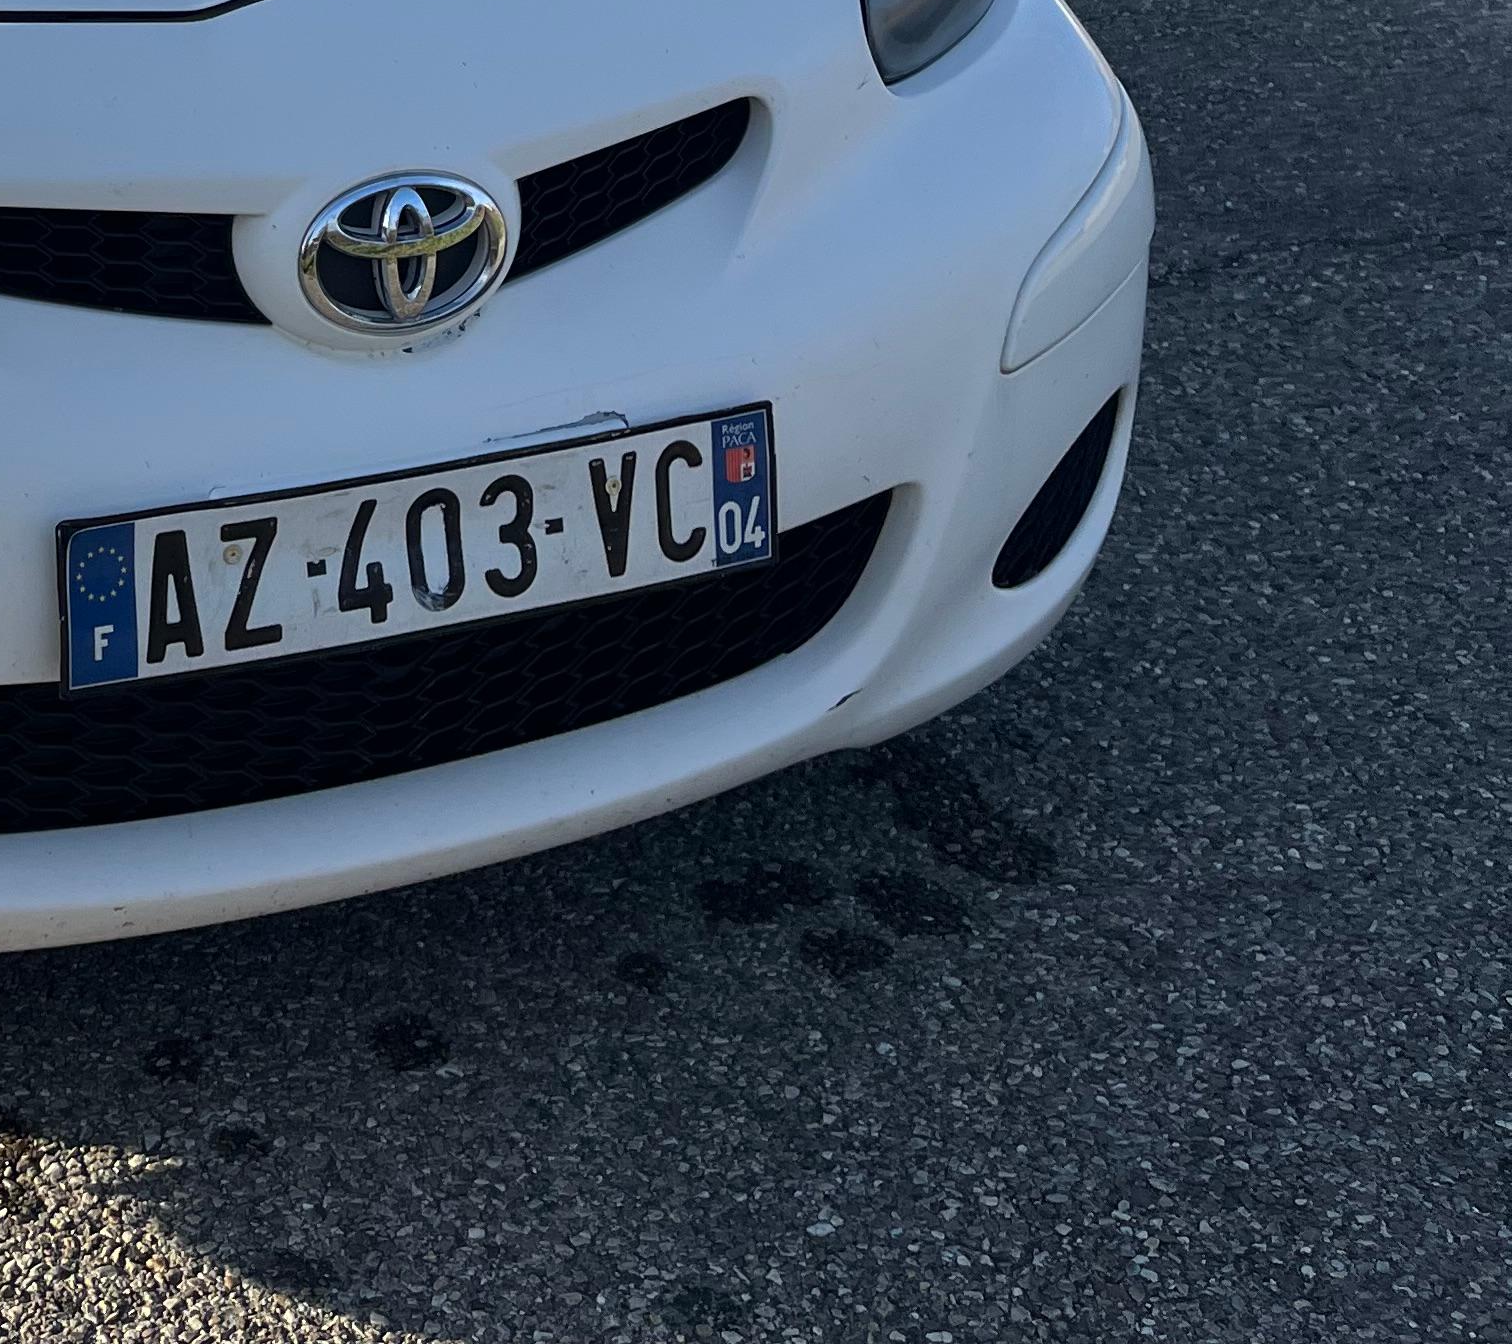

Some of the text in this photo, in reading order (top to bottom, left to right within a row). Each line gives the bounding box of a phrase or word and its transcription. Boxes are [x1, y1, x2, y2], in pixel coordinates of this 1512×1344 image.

[721, 422, 754, 435] Région
[721, 431, 757, 449] PACA
[718, 495, 766, 554] 04
[145, 439, 708, 665] AZ-403-VC
[93, 624, 115, 663] F
